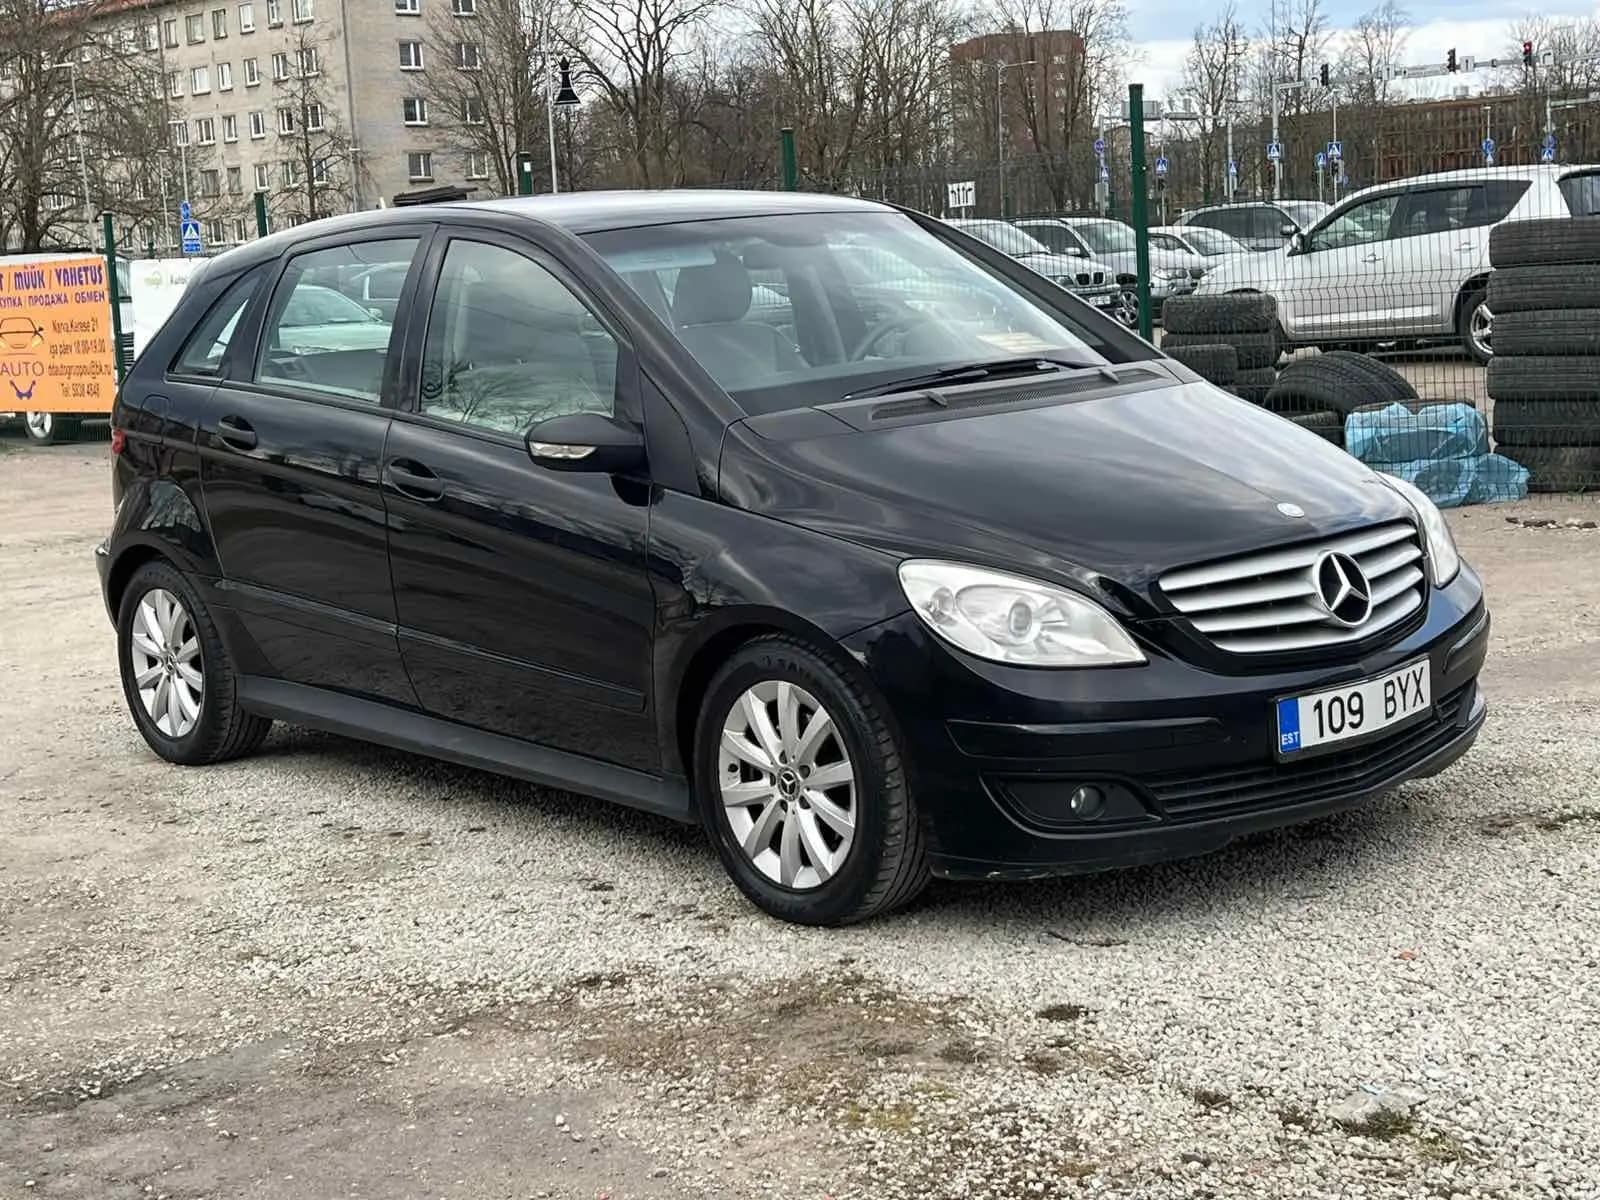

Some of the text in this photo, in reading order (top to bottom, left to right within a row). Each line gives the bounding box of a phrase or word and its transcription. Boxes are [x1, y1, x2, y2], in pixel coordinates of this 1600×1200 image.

[14, 265, 45, 290] MÜÜK
[55, 264, 103, 288] VAHETUS
[28, 293, 68, 308] ПРОДАЖА
[75, 290, 105, 304] ОБМЕН
[0, 361, 44, 376] AUTO
[1313, 666, 1425, 738] 109 BYX
[1281, 731, 1299, 746] EST
